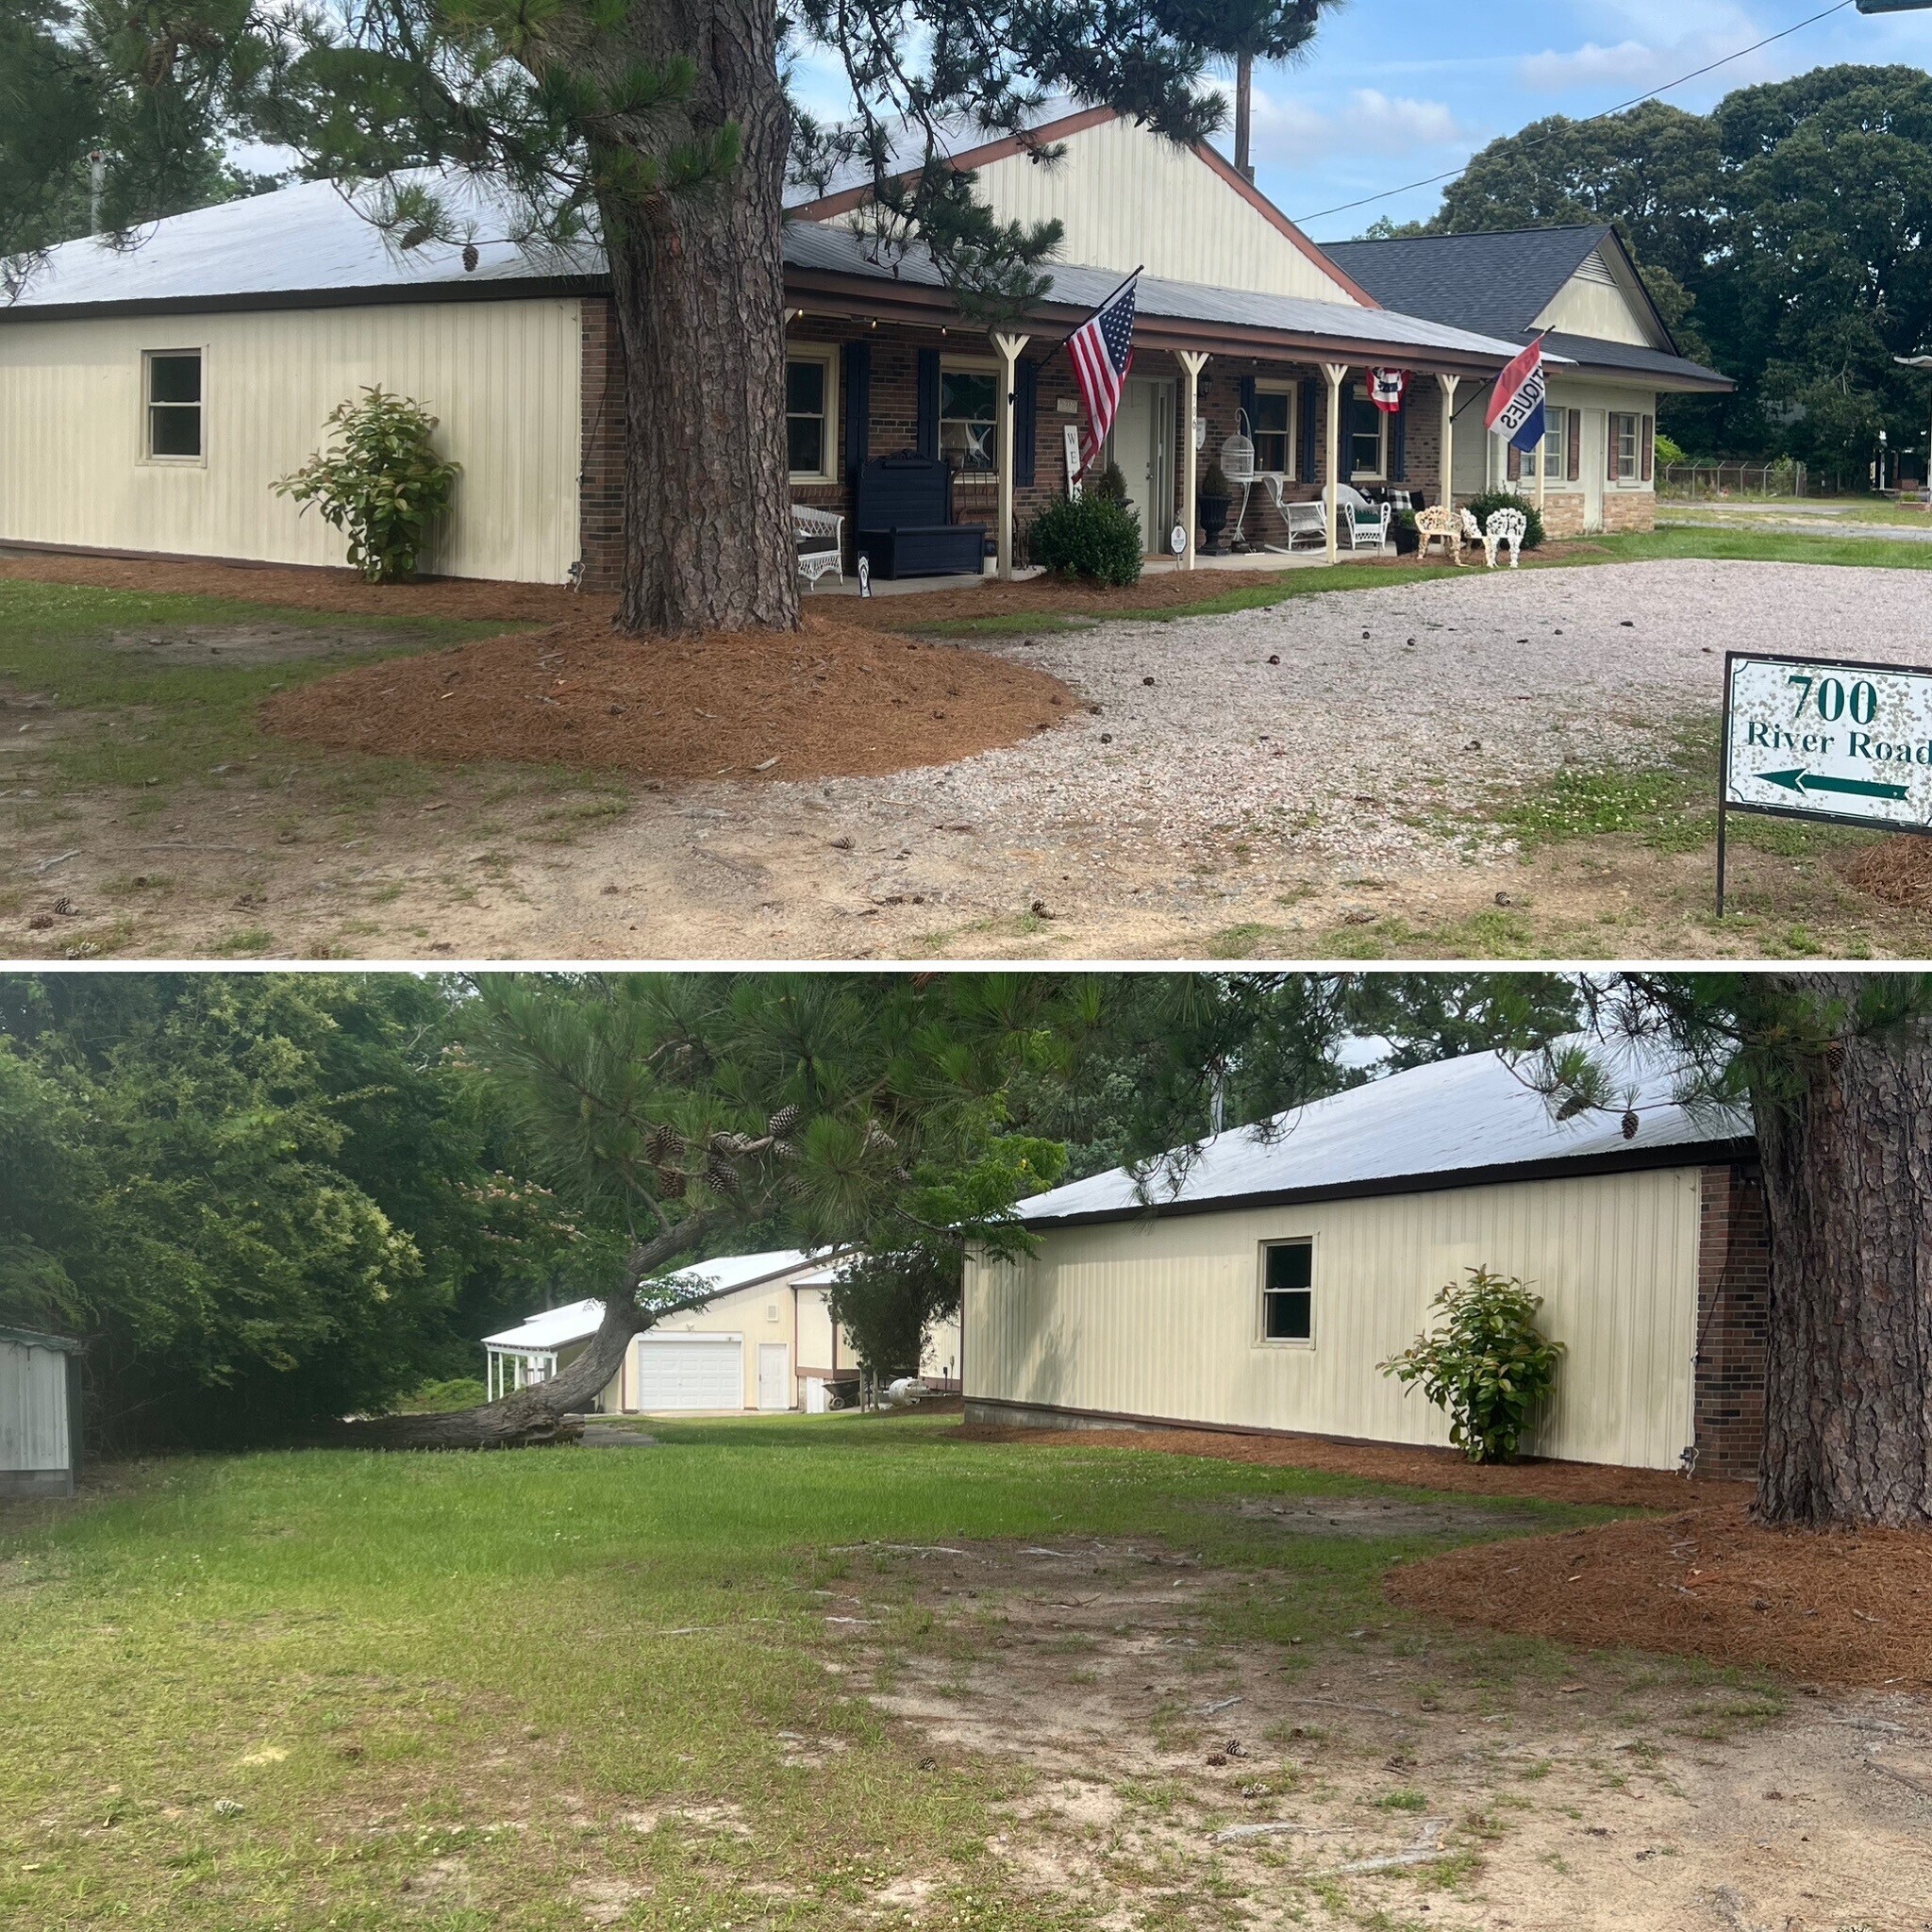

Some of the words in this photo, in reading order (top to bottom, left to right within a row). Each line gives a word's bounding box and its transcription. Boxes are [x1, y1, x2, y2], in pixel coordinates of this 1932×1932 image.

[1788, 675, 1877, 725] 700
[1747, 721, 1835, 754] River
[1848, 731, 1932, 766] Road
